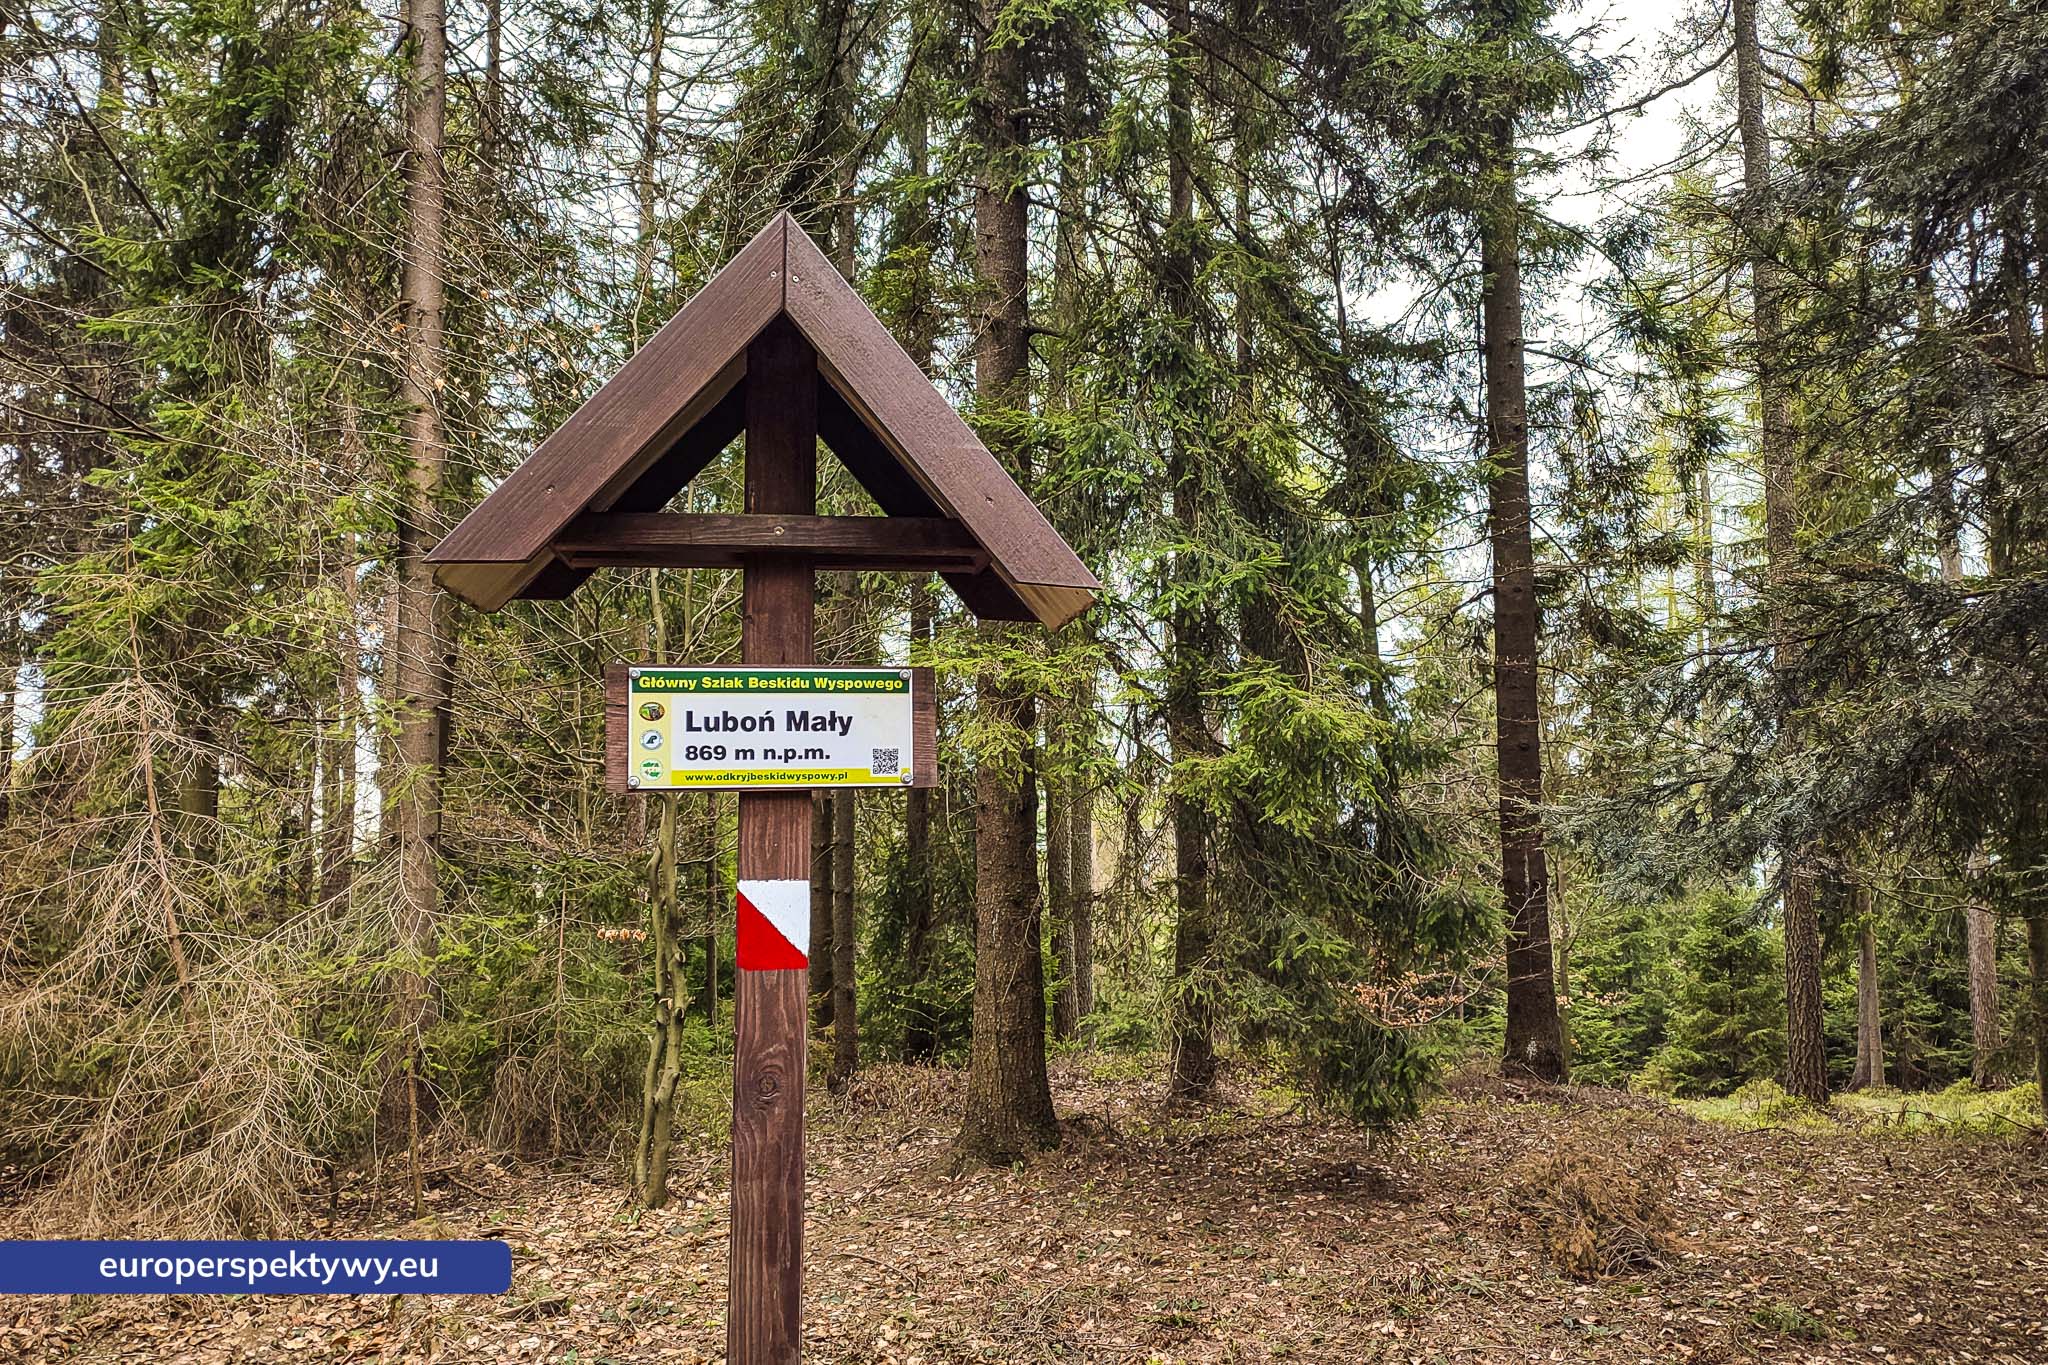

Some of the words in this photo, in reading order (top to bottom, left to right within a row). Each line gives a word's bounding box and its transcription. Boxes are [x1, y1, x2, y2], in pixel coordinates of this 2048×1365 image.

[638, 676, 697, 691] Główny
[701, 676, 744, 689] Szlak
[748, 677, 810, 689] Beskidu
[813, 677, 903, 691] Wyspowego
[685, 710, 775, 732] Luboń
[786, 710, 853, 737] Mały
[684, 745, 727, 761] 869
[734, 748, 755, 761] m
[763, 747, 831, 763] n.p.m.
[685, 771, 848, 782] www.odkryjbeskidwyspowy.pl
